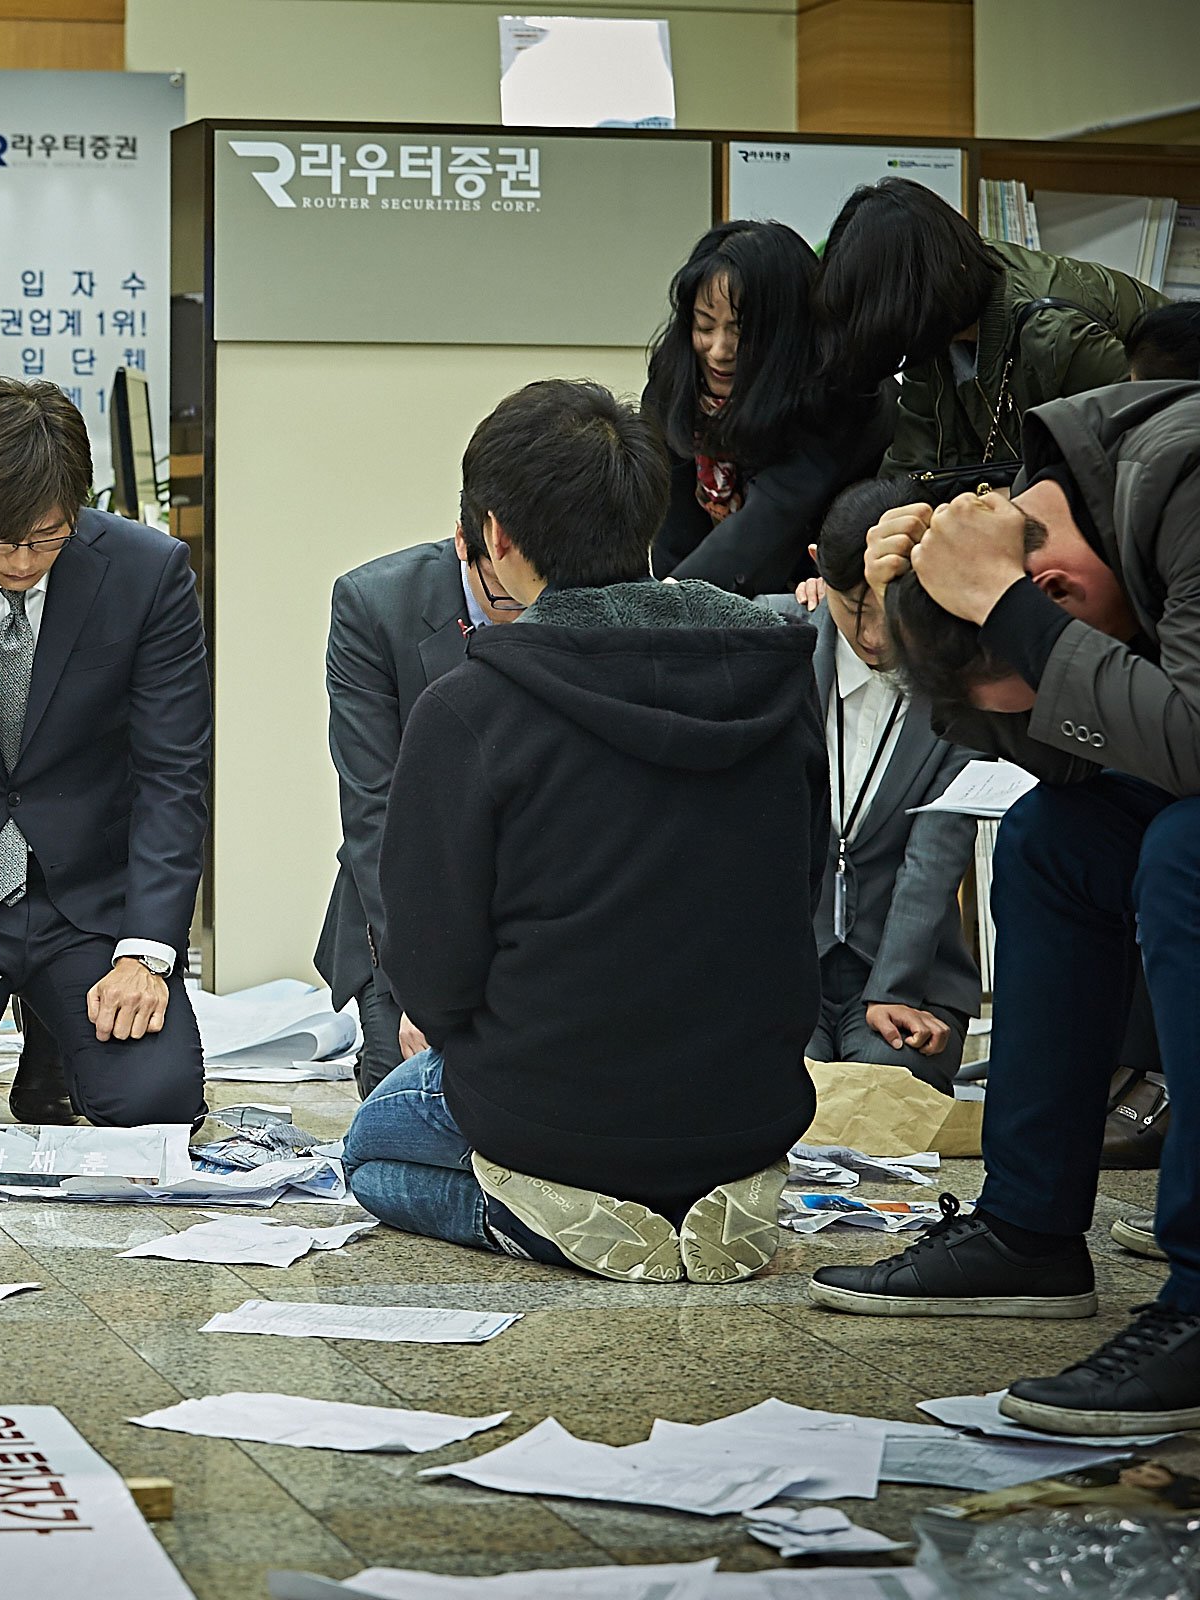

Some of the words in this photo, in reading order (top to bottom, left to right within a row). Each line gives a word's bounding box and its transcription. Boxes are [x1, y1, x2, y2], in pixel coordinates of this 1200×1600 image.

[300, 143, 542, 200] 라우터증권
[301, 196, 371, 210] ROUTER
[380, 198, 482, 212] SECURITIES
[490, 200, 542, 213] CORP.
[96, 309, 147, 337] 1위!
[747, 1171, 767, 1206] eebok
